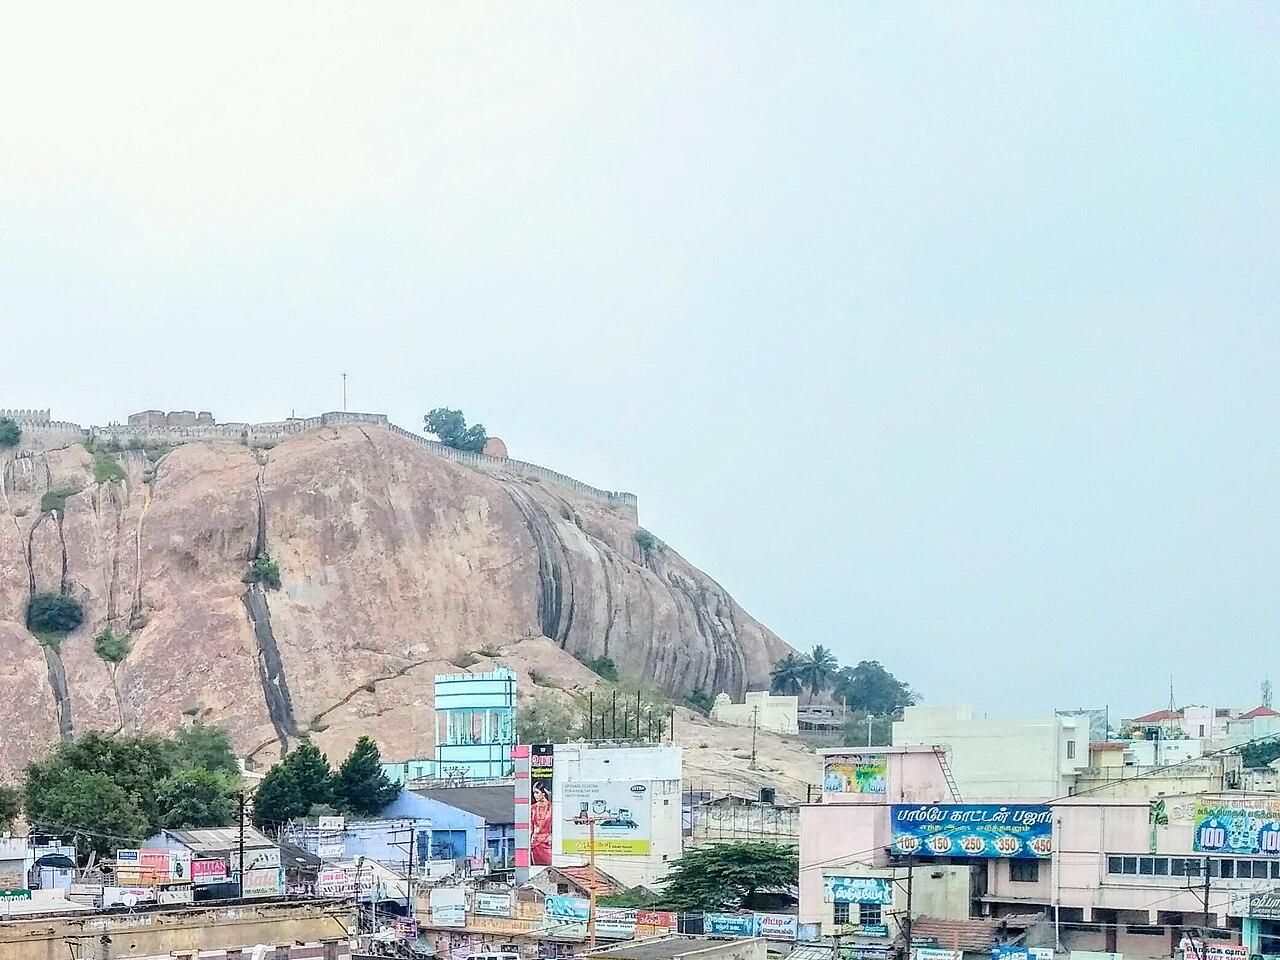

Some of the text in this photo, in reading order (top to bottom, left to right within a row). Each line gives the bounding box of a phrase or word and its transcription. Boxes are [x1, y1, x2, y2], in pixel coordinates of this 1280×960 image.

[897, 806, 946, 822] பாம்பே
[949, 807, 1011, 823] காட்டன்
[899, 838, 1052, 852] 100 150 250 350 450
[1200, 827, 1225, 848] 100
[201, 861, 227, 871] TITAN
